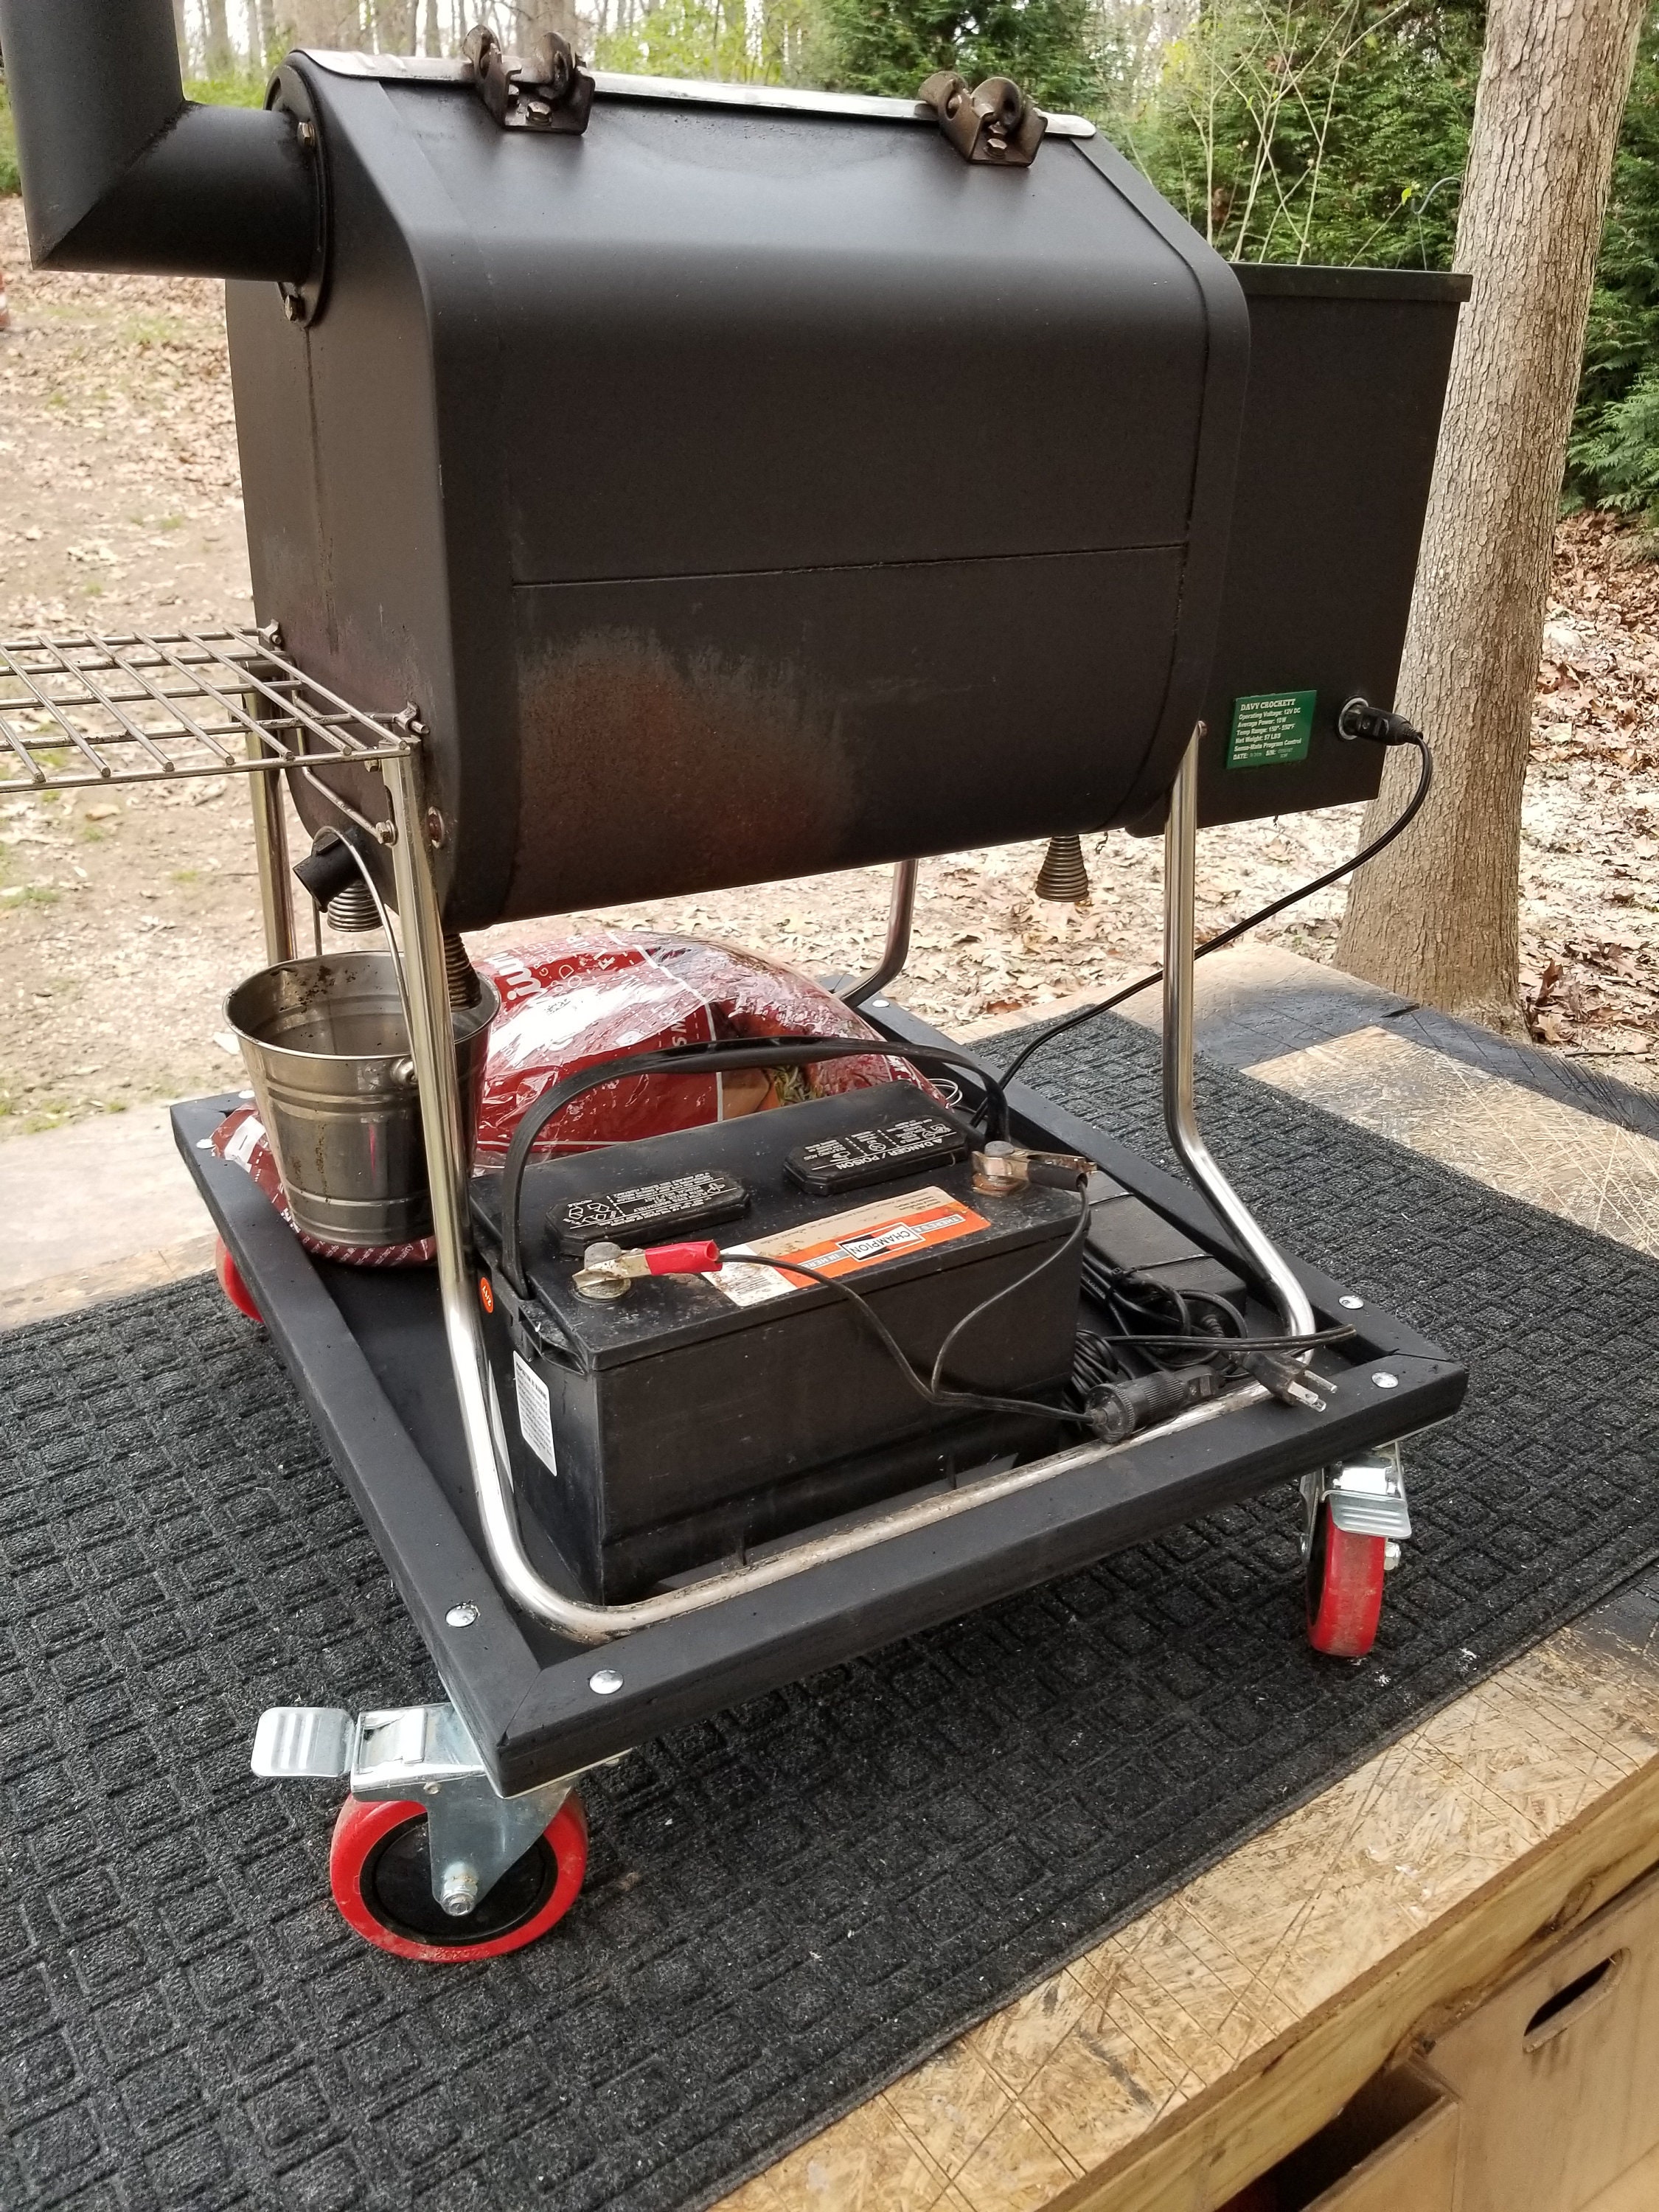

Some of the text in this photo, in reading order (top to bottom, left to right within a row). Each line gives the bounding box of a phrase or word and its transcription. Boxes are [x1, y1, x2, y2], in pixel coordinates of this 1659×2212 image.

[1240, 698, 1295, 711] DAVY CROCKETT
[1239, 712, 1262, 721] Operating
[1263, 741, 1283, 749] Program
[1233, 752, 1248, 760] DATE:
[888, 1141, 934, 1156] DANGER
[836, 1155, 880, 1169] POISON
[849, 1231, 911, 1254] CHAMPION
[801, 1257, 829, 1269] HERE
